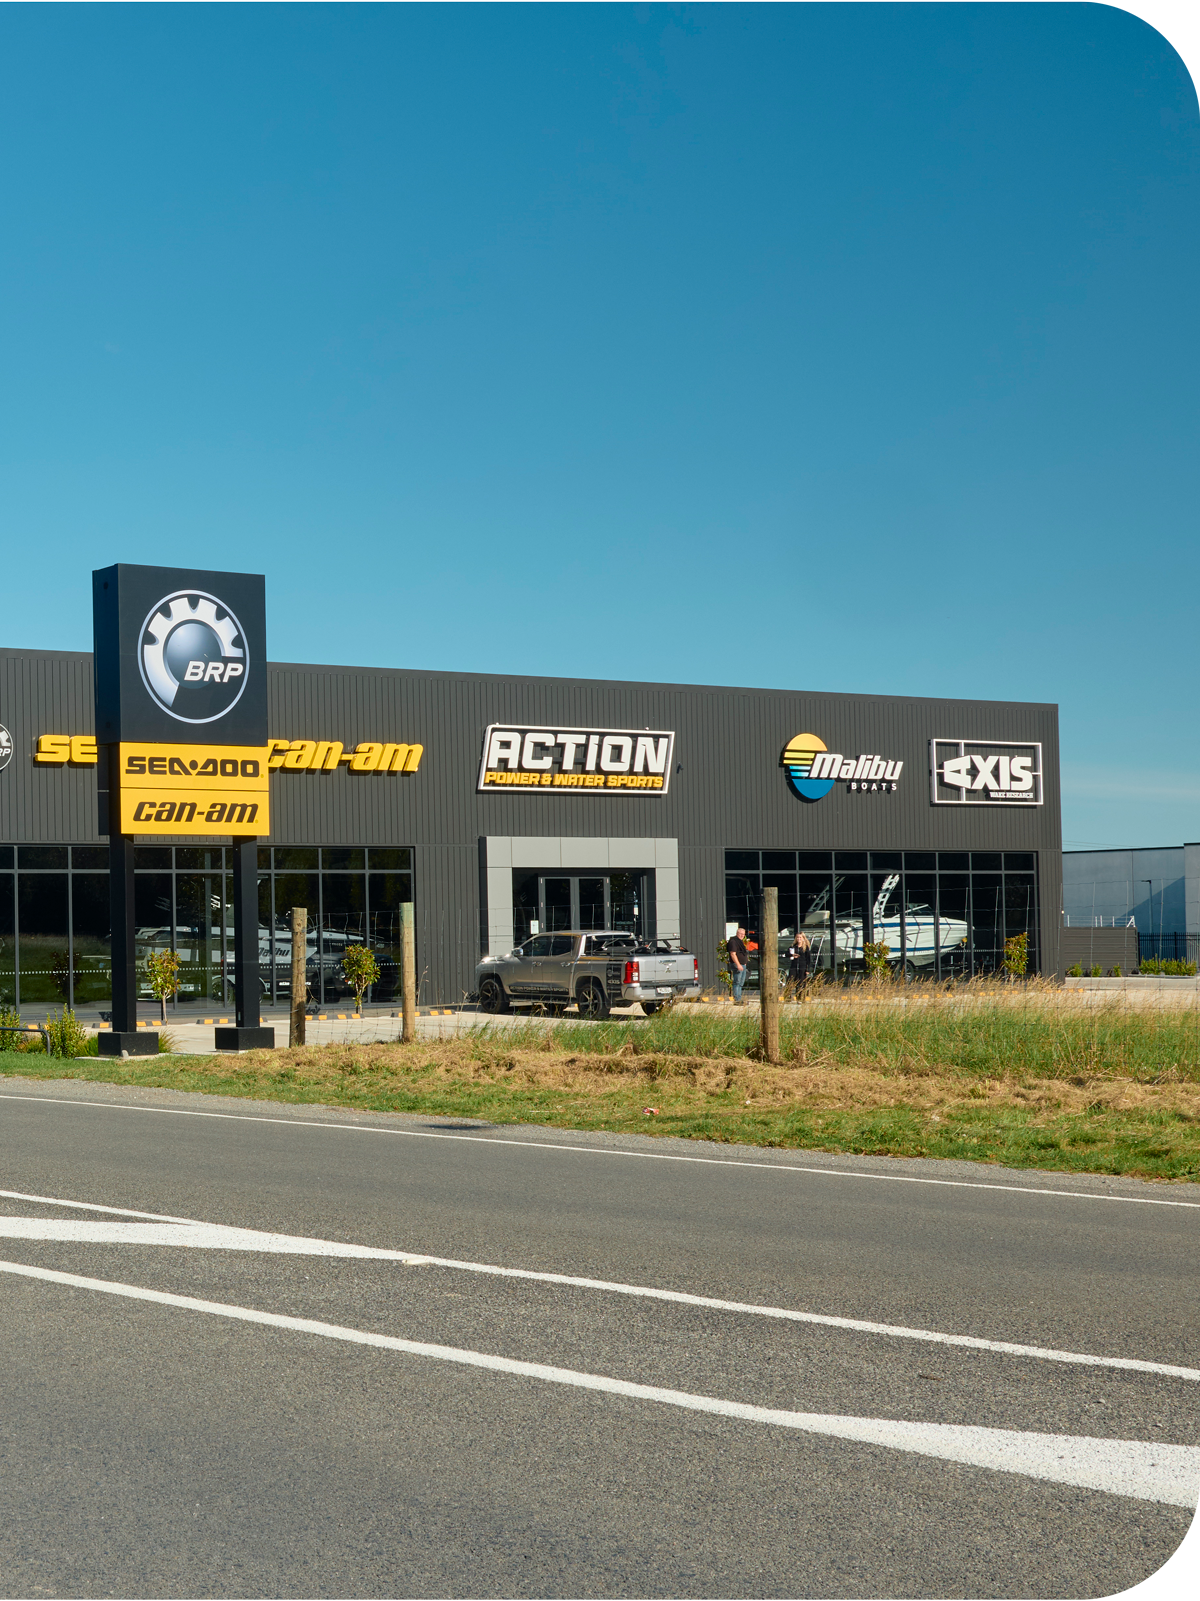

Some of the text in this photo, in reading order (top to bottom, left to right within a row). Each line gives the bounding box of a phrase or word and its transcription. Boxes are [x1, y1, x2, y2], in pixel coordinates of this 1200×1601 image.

[184, 660, 244, 683] BRP
[487, 731, 669, 773] ACTION
[809, 753, 904, 780] Malibu
[944, 755, 1033, 791] AXIS
[484, 772, 664, 788] POWER & WATER SPORTS
[851, 782, 898, 790] BOATS
[133, 802, 259, 824] can-am
